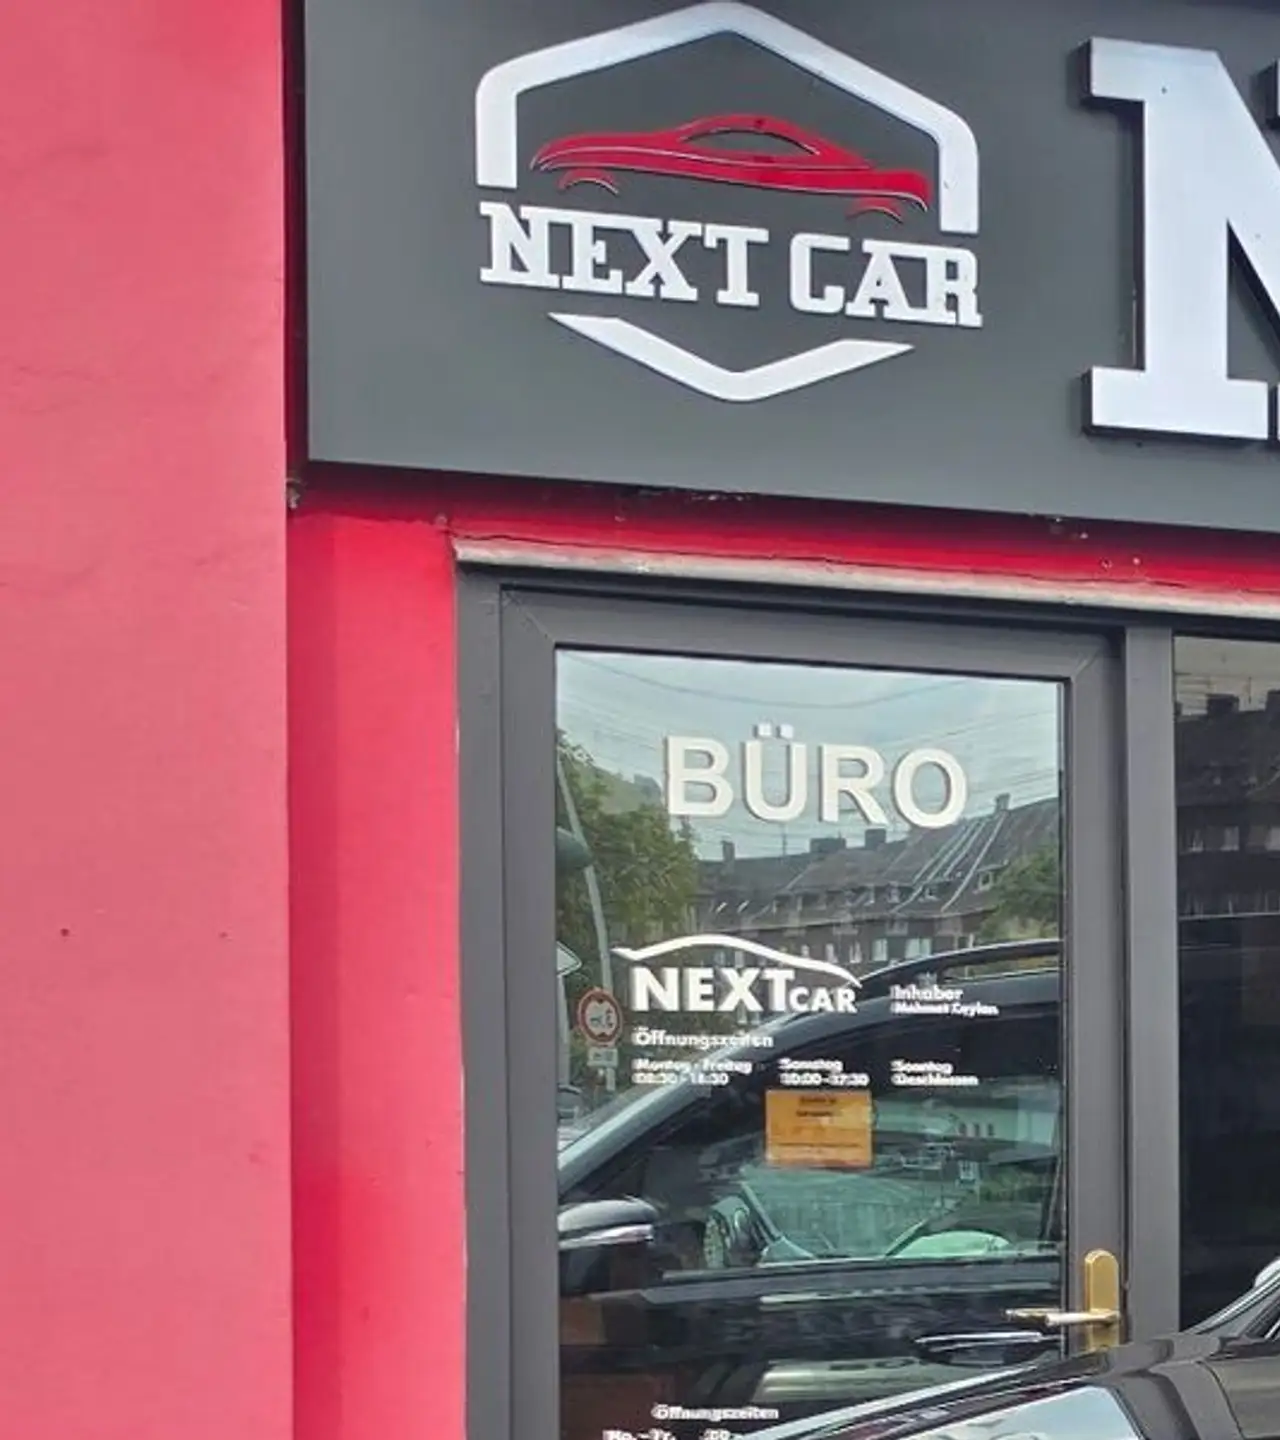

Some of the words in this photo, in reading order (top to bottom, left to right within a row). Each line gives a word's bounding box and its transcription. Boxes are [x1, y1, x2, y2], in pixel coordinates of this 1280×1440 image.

[479, 201, 769, 307] NEXT
[789, 232, 983, 328] CAR
[665, 722, 970, 830] BÜRO
